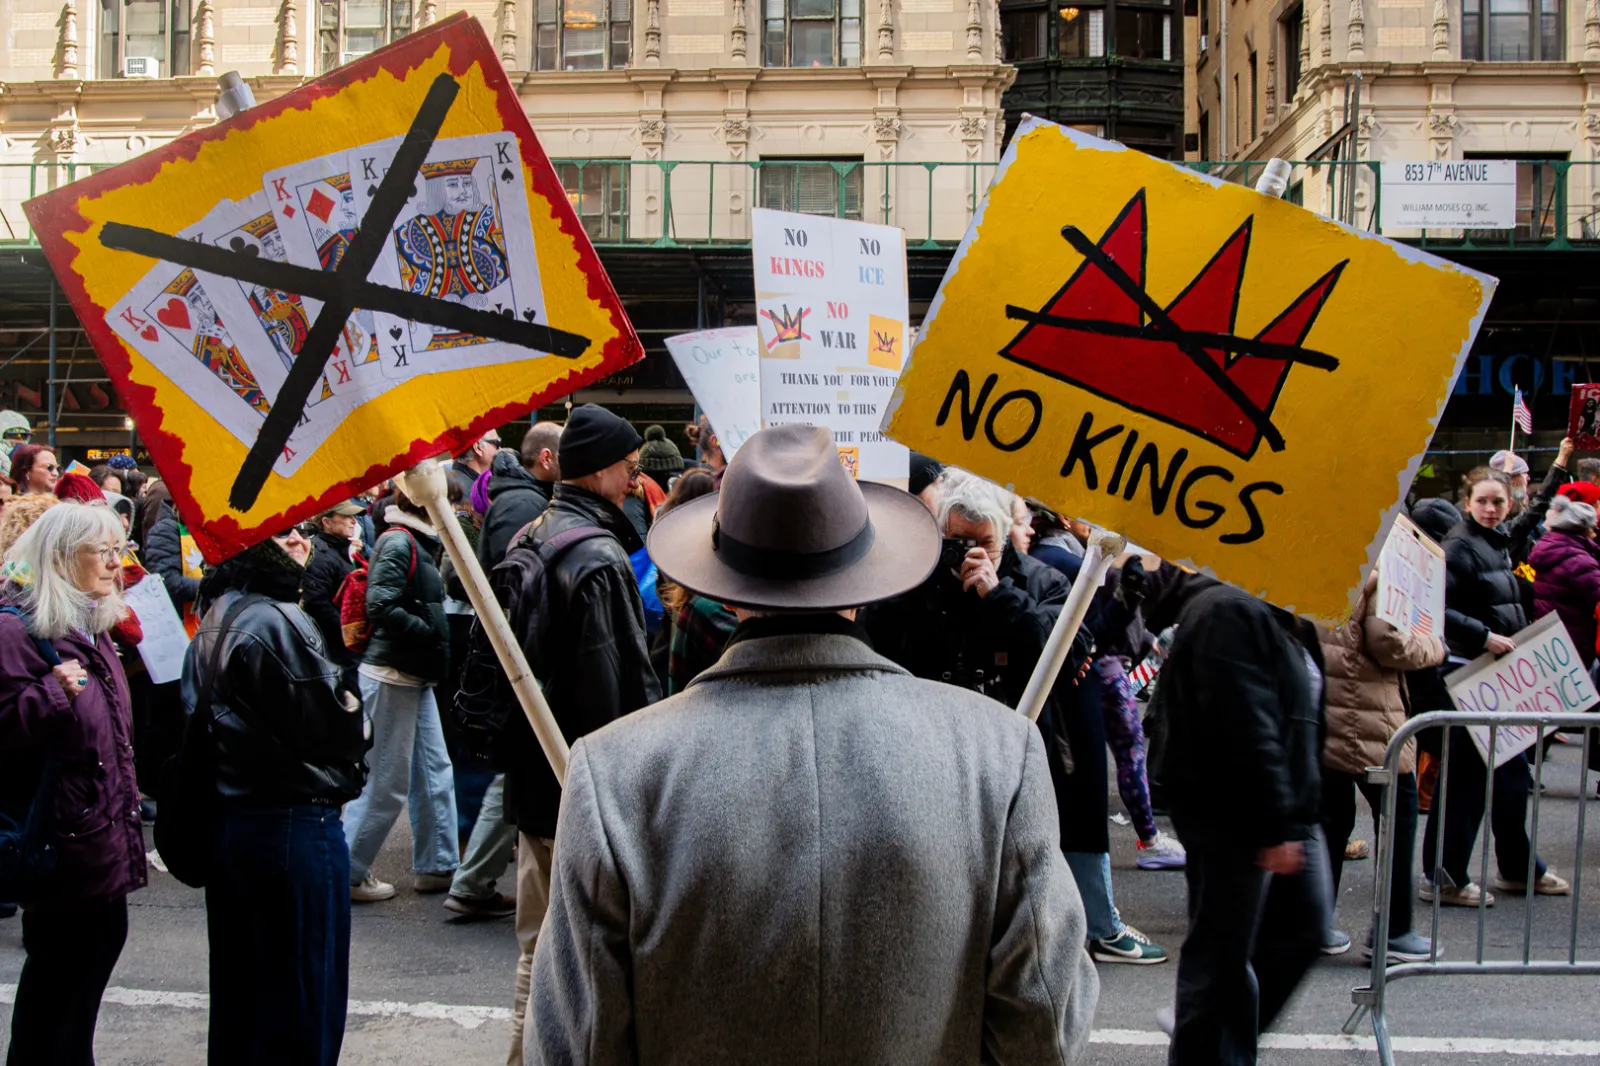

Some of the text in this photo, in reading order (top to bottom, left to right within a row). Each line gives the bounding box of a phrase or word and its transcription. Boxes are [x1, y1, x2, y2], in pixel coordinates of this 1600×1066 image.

[495, 142, 513, 165] K
[361, 157, 378, 181] K
[1405, 162, 1488, 181] 853 7TH AVENUE
[271, 176, 292, 202] K
[1402, 203, 1433, 212] WILLIAM
[1435, 203, 1460, 212] MOSES
[784, 228, 807, 247] NO
[859, 237, 880, 256] NO
[770, 256, 824, 279] KINGS
[859, 265, 884, 286] ICE
[120, 305, 146, 332] K
[827, 301, 848, 320] NO
[821, 330, 857, 349] WAR
[691, 345, 722, 365] Our
[734, 372, 758, 384] are
[780, 372, 819, 386] THANK
[823, 375, 844, 387] YOU
[850, 374, 870, 386] FOR
[770, 402, 877, 415] ATTENTION TO THIS
[834, 431, 854, 443] THE
[935, 369, 1284, 545] NO KINGS
[1553, 667, 1593, 711] ICE
